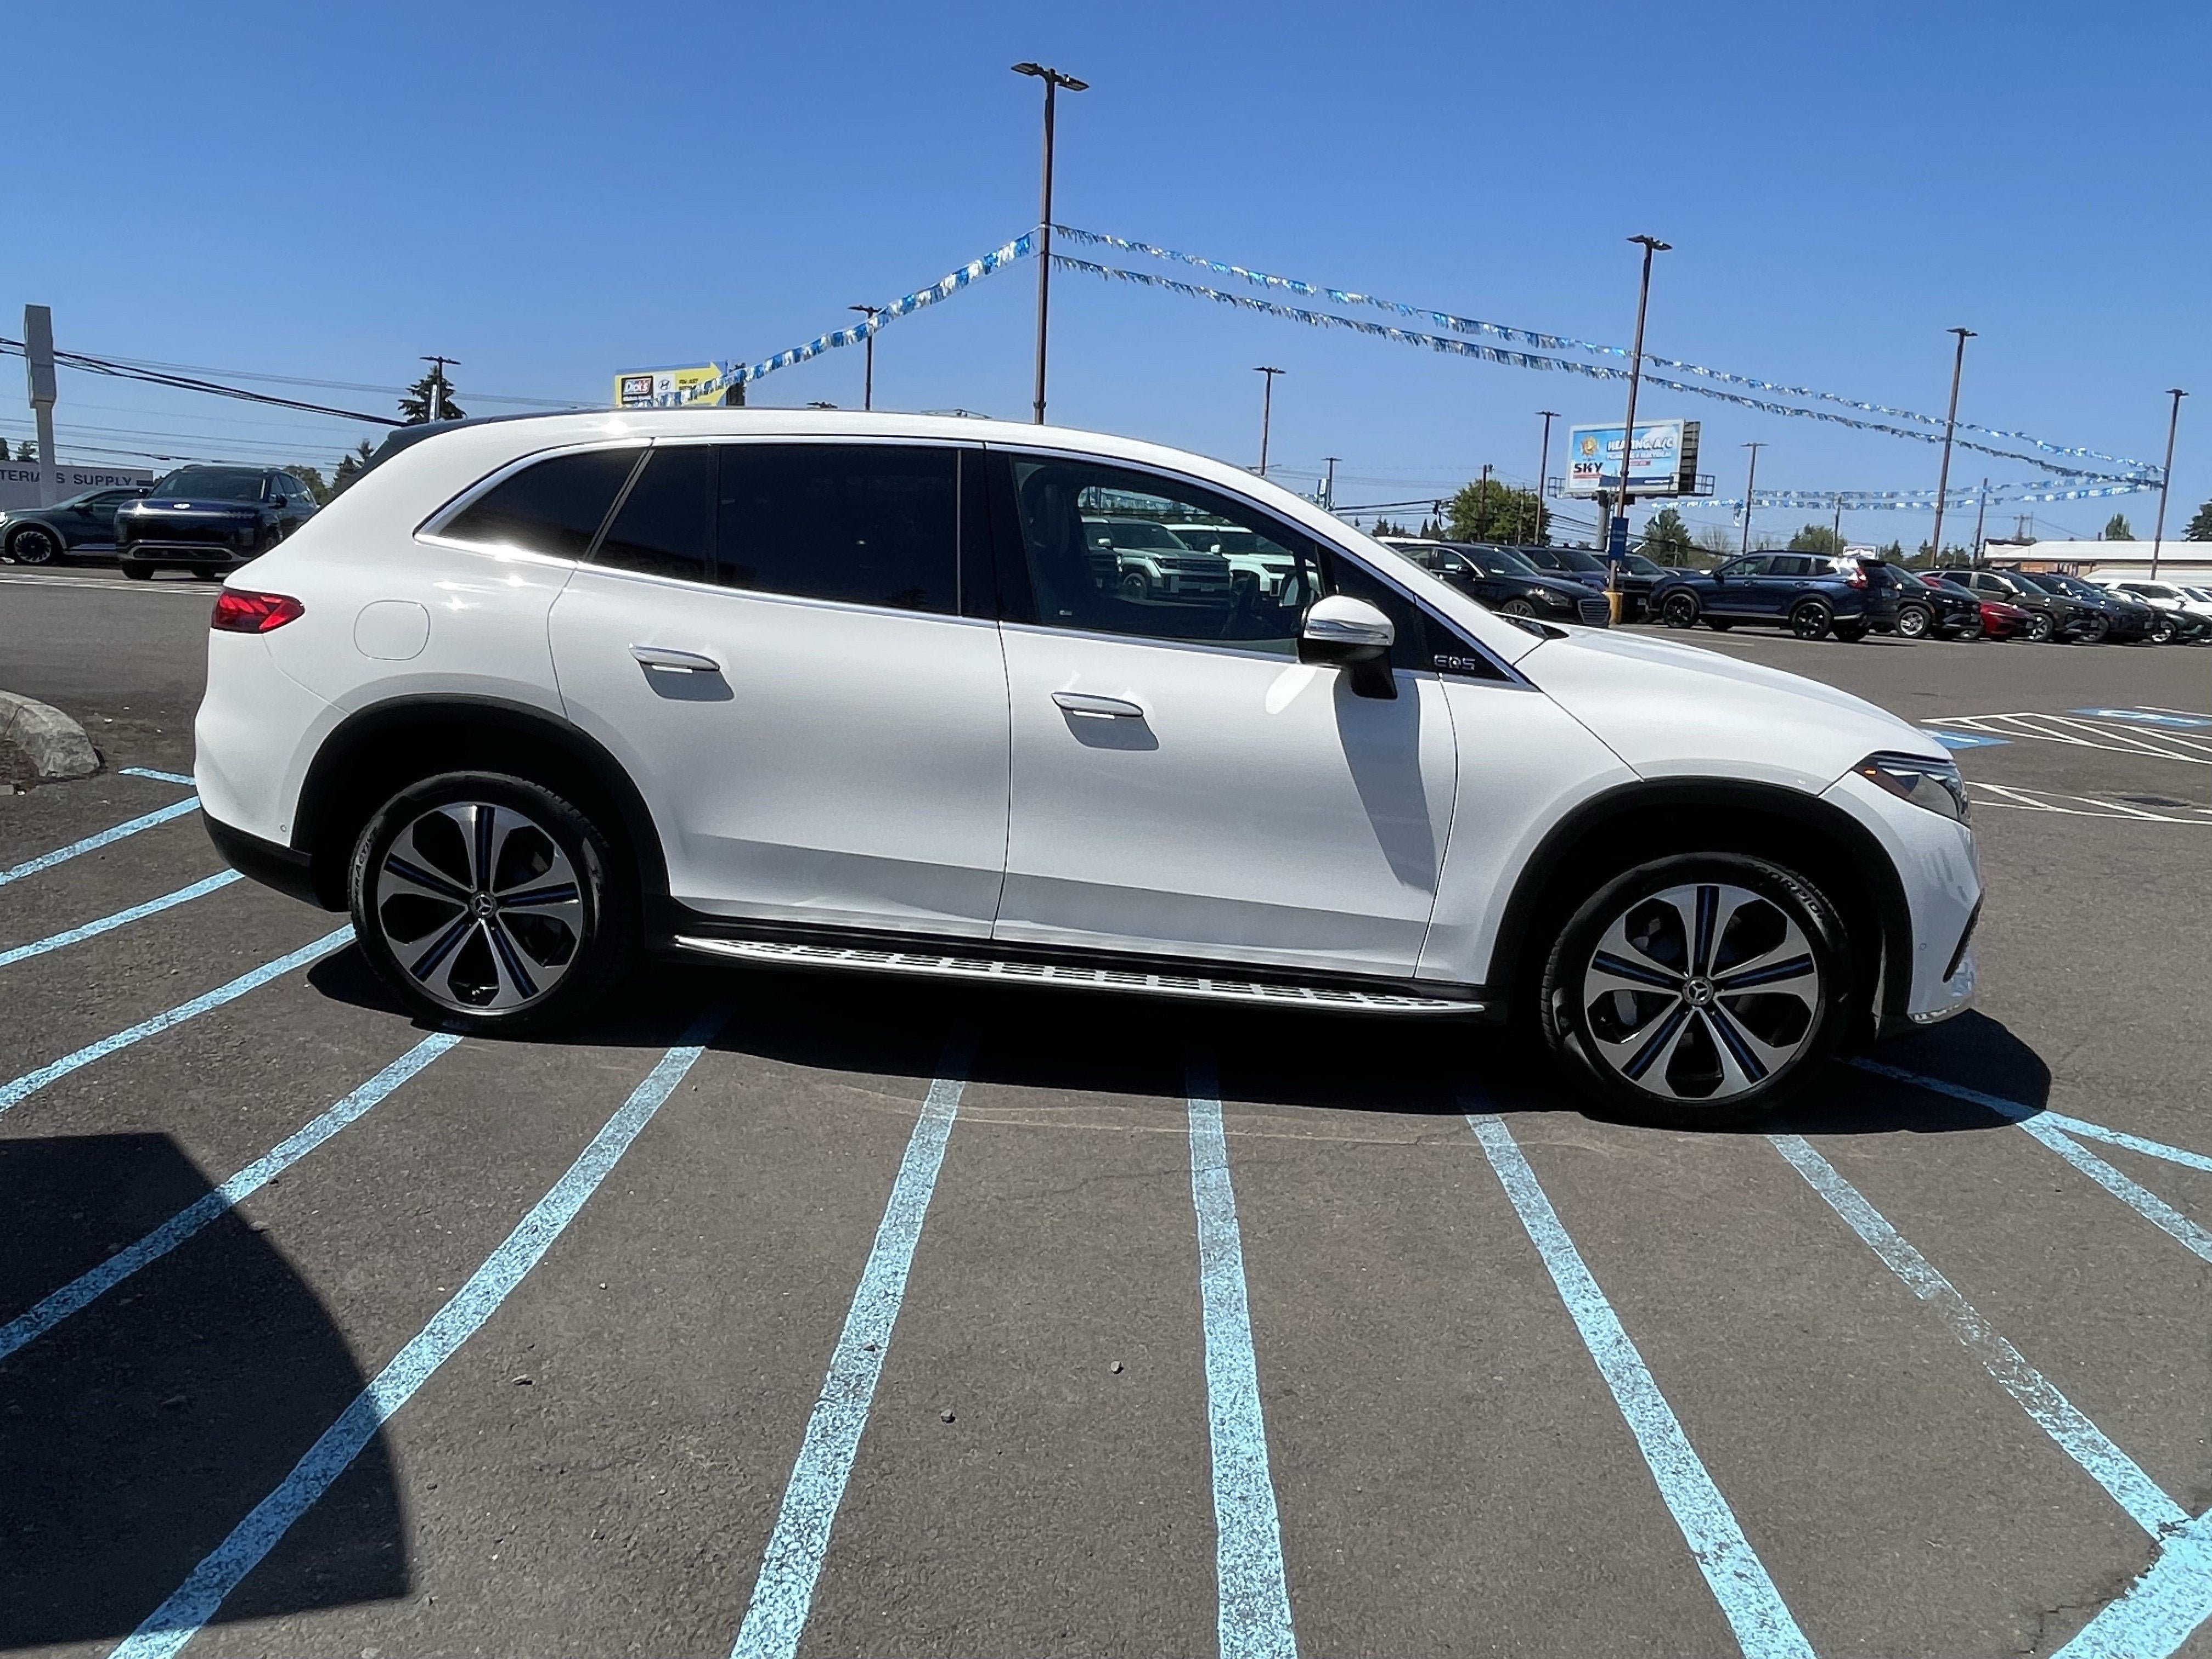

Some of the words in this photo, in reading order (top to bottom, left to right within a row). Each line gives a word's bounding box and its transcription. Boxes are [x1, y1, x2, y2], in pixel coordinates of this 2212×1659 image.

[1573, 462, 1603, 473] SKY
[0, 470, 66, 483] TERIAS
[74, 474, 132, 486] SUPPLY
[1434, 654, 1476, 670] EQS
